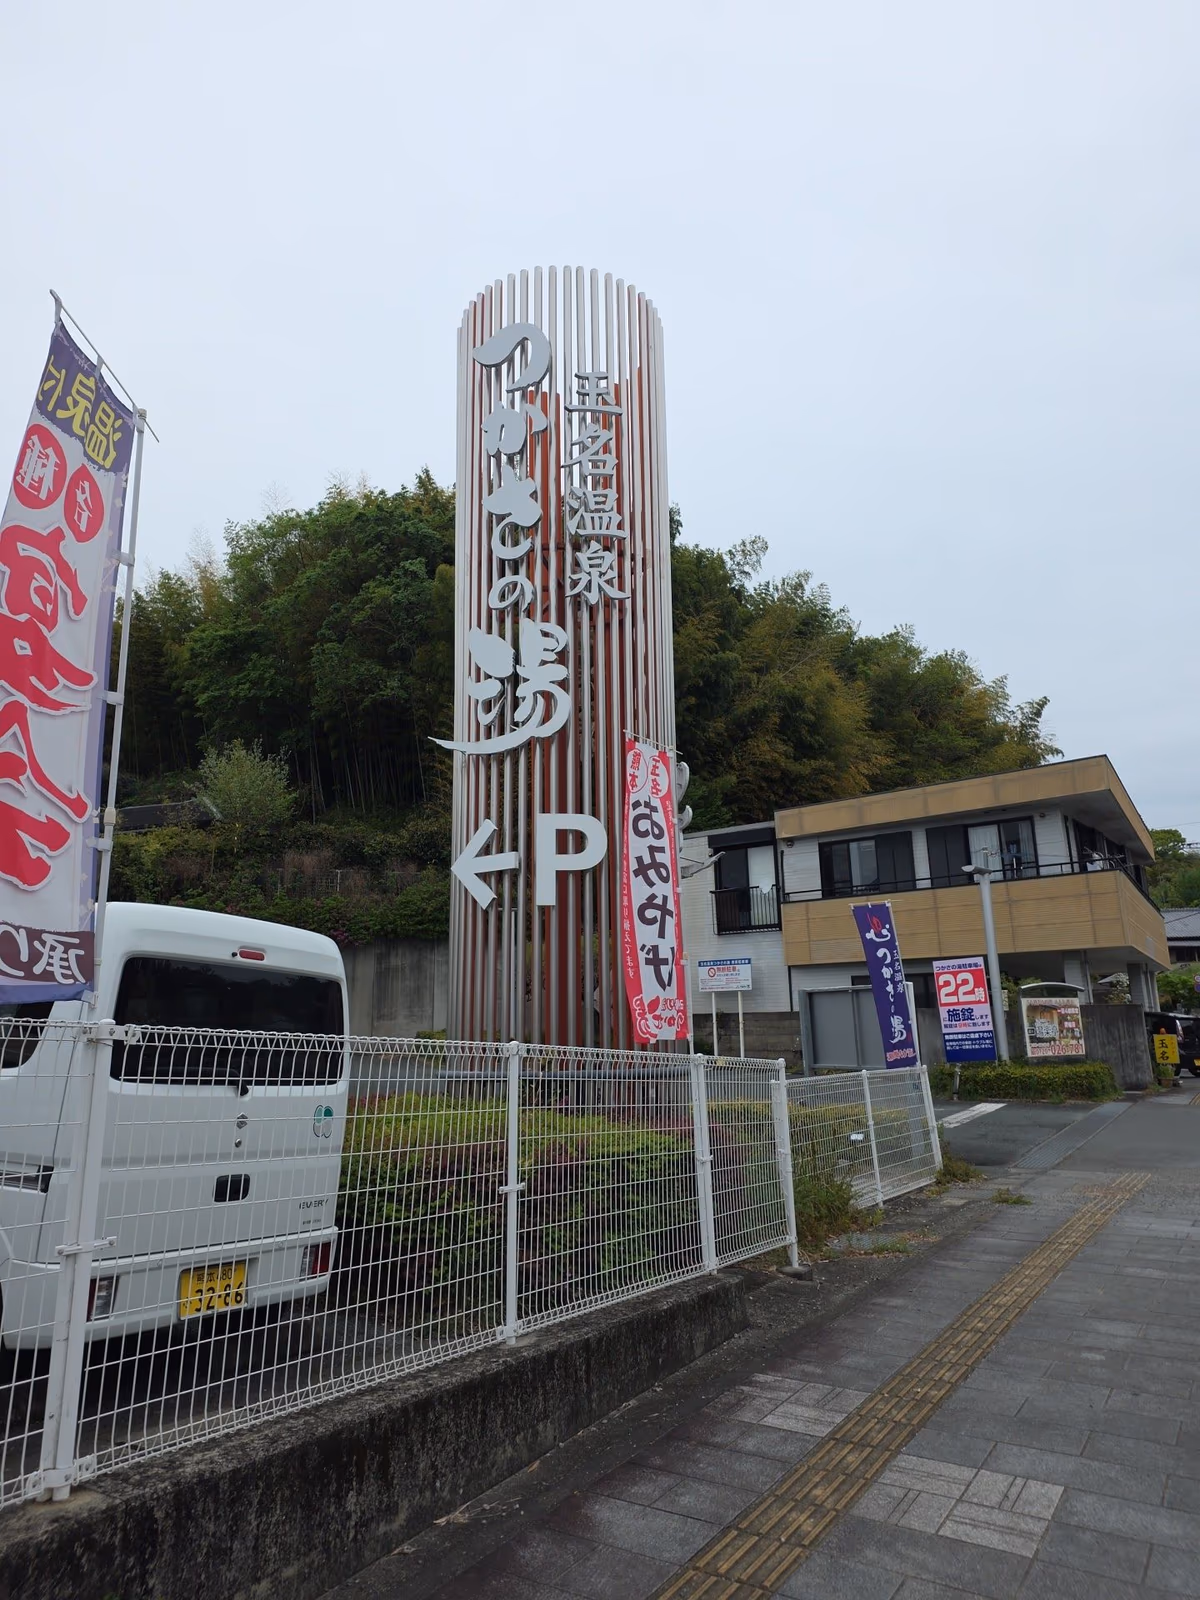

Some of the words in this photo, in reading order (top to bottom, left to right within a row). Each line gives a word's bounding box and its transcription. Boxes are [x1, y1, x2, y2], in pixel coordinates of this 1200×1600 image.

[427, 321, 572, 755] つかさの湯
[560, 370, 631, 605] 玉名温泉
[535, 812, 608, 906] P
[938, 972, 985, 1004] 22時
